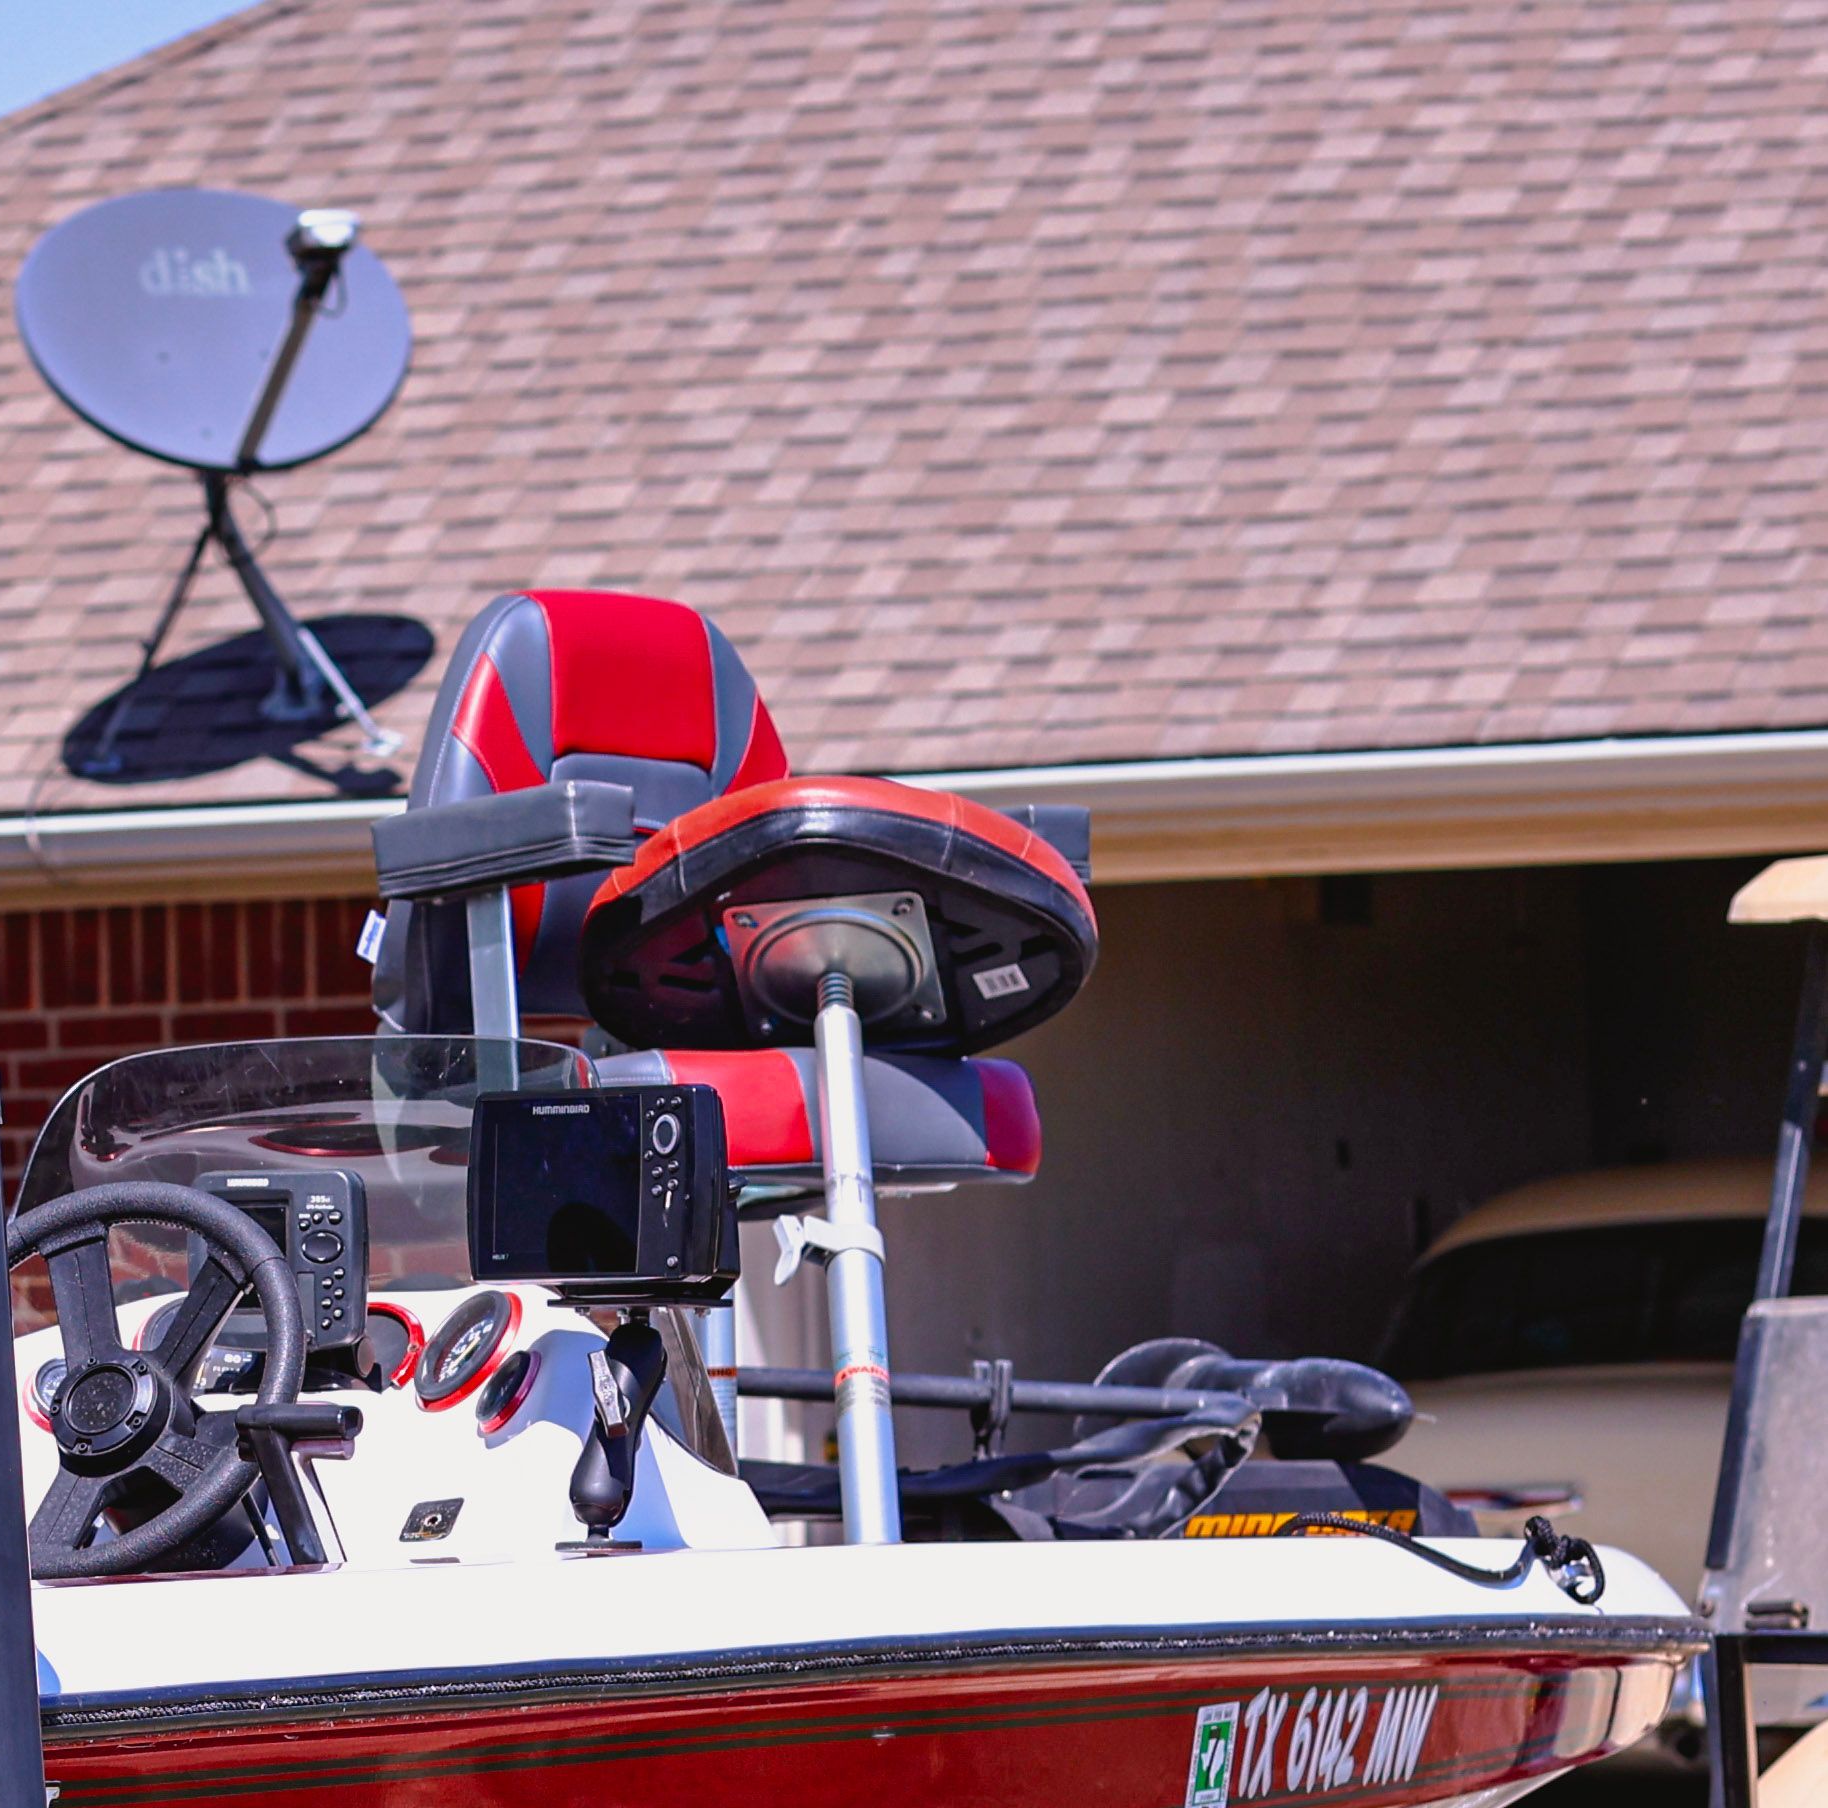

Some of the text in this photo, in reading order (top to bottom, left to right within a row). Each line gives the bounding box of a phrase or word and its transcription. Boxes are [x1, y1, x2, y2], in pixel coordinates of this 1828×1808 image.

[139, 246, 253, 298] dish
[1238, 1685, 1290, 1800] TX
[1286, 1685, 1369, 1795] 6142
[1362, 1684, 1440, 1788] MW
